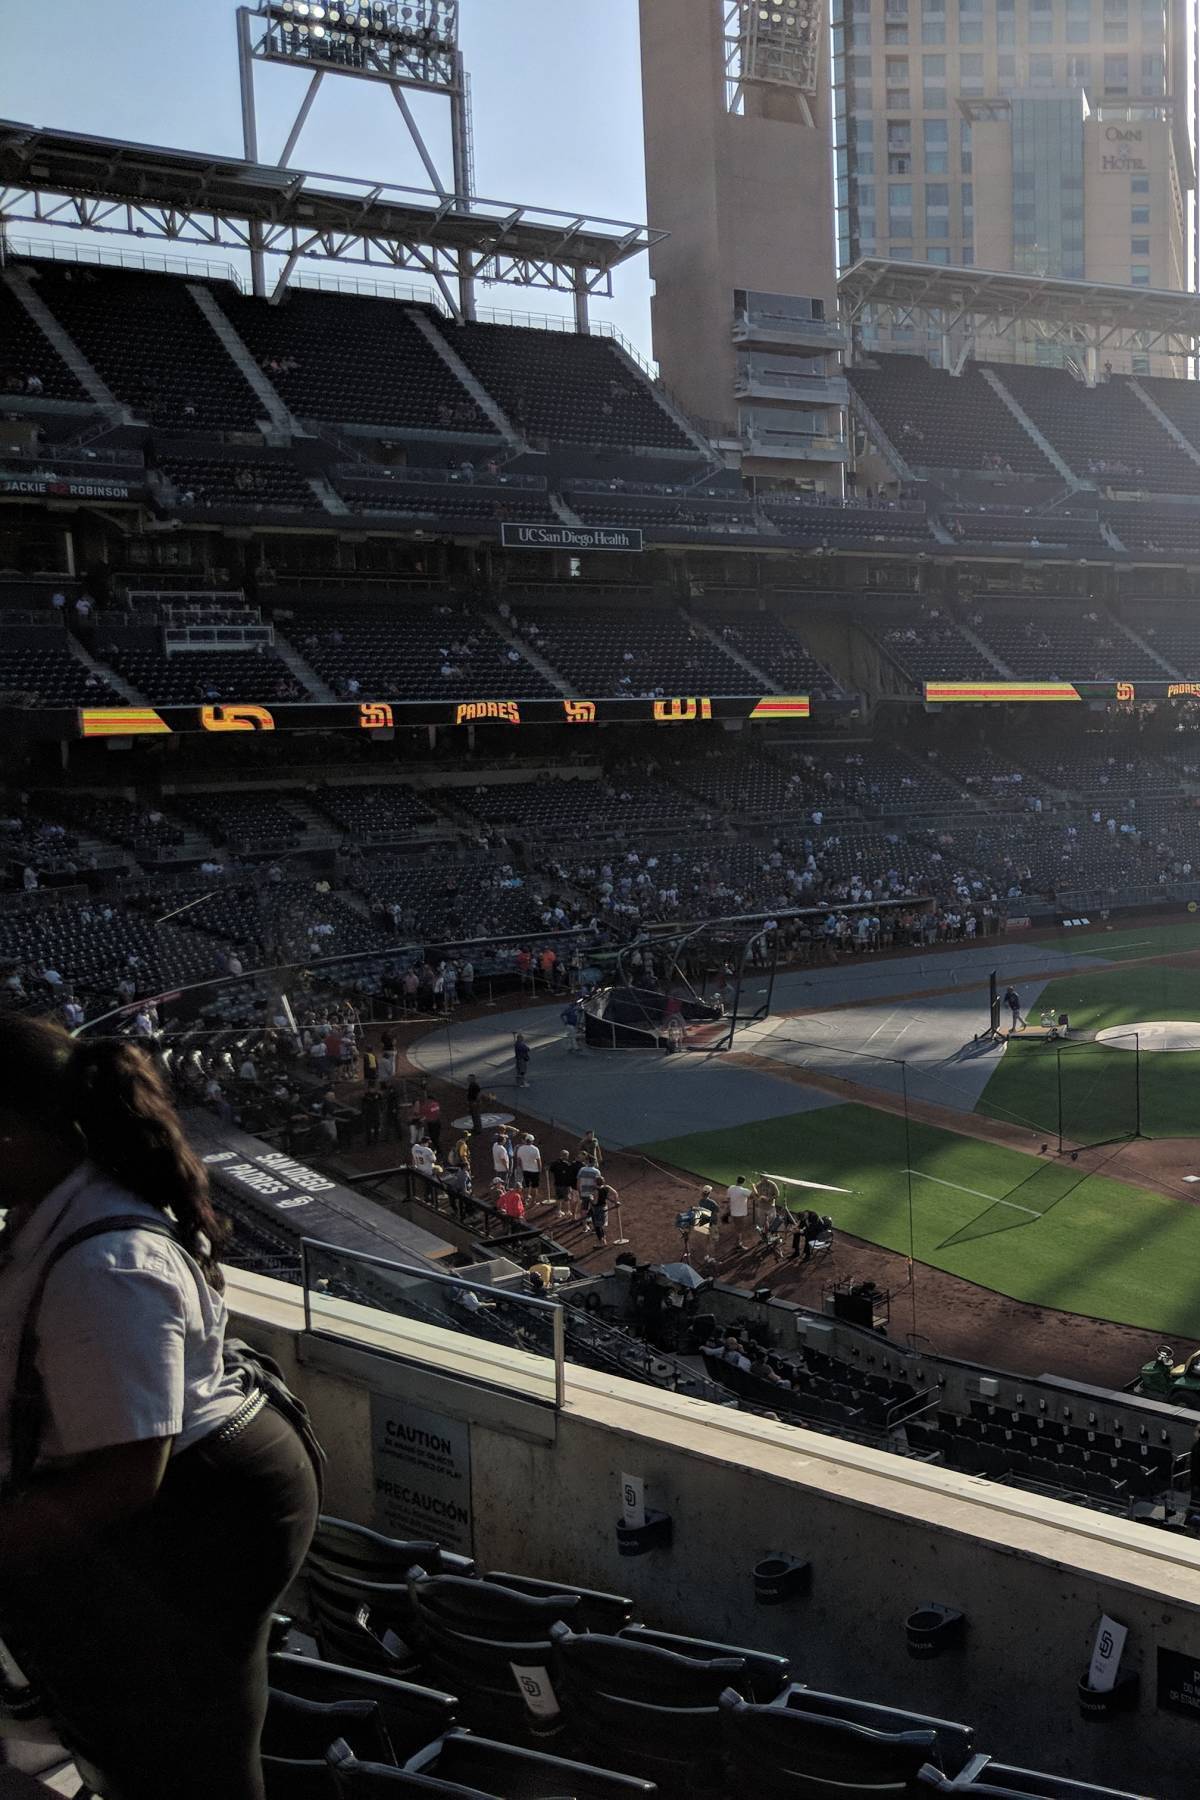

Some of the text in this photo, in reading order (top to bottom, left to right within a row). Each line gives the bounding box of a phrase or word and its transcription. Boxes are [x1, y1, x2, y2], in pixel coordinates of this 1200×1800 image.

[5, 482, 47, 493] JACKIE
[70, 485, 128, 497] ROBINSON
[518, 528, 630, 546] UC San Diego Health
[457, 701, 521, 725] PADRES
[223, 1163, 290, 1195] PADRES
[255, 1152, 336, 1192] SAN DIEGO
[386, 1420, 452, 1455] CAUTION
[377, 1478, 468, 1524] PRECAUCIÓN
[1169, 1689, 1179, 1701] OR
[1183, 1682, 1194, 1694] DO
